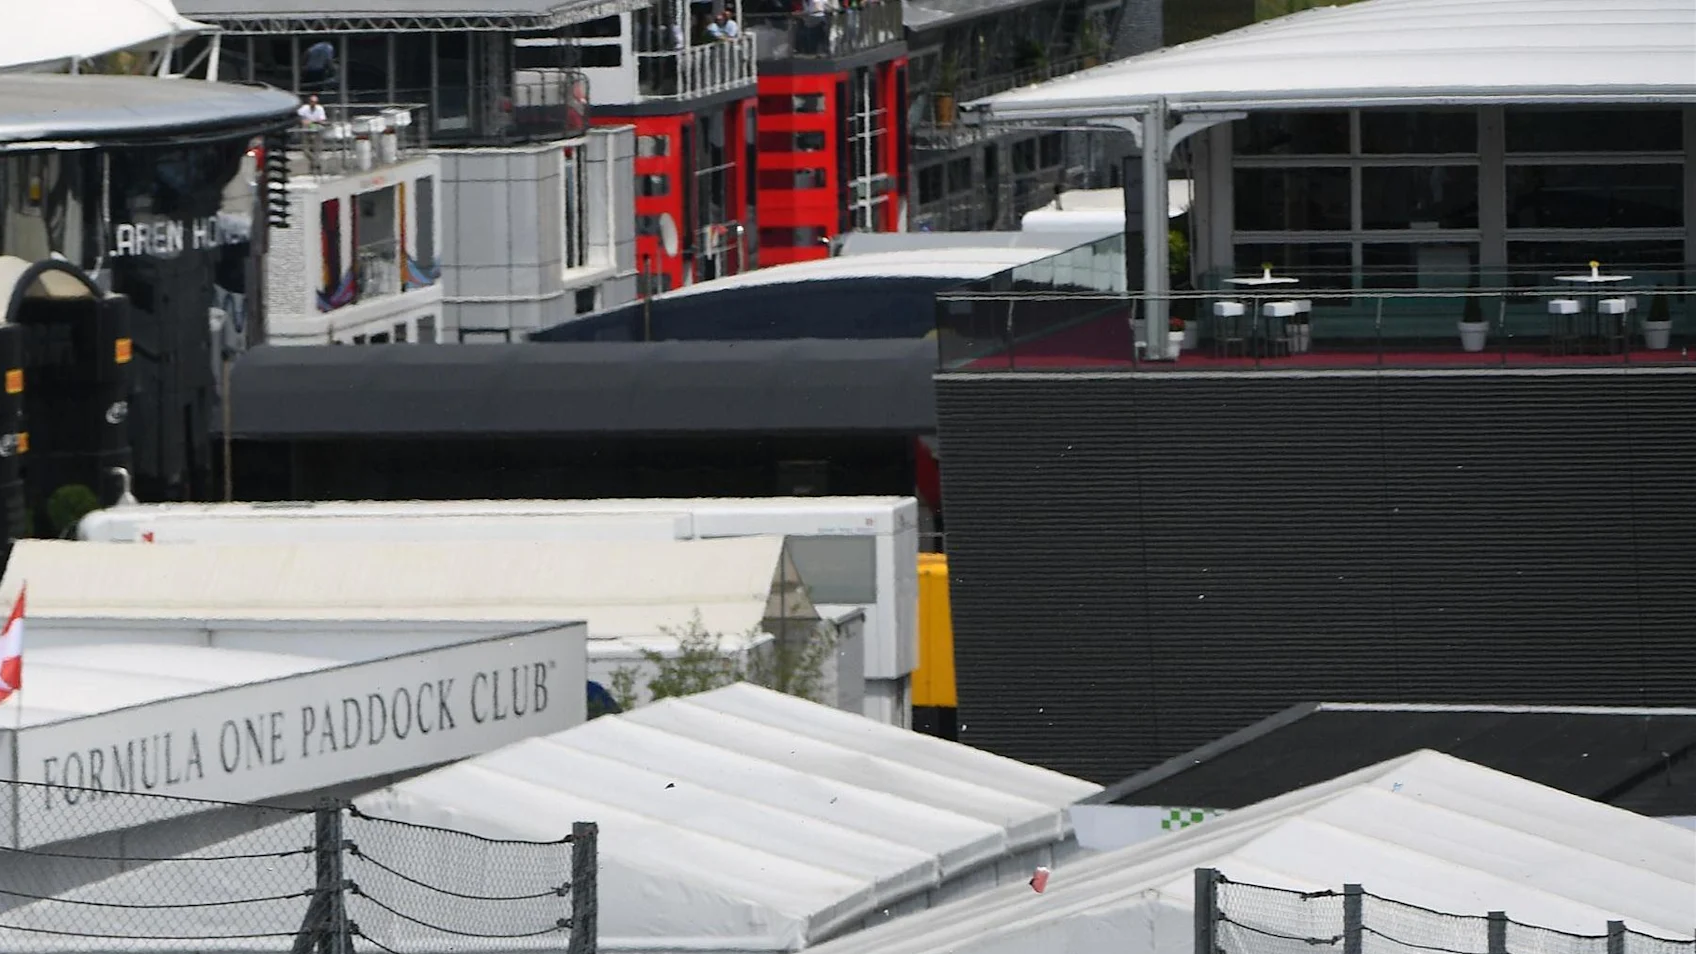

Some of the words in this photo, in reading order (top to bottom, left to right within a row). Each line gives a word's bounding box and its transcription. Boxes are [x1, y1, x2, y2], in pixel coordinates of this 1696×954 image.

[42, 727, 205, 810] FORMULA
[218, 711, 286, 773] ONE
[302, 678, 457, 759] PADDOCK
